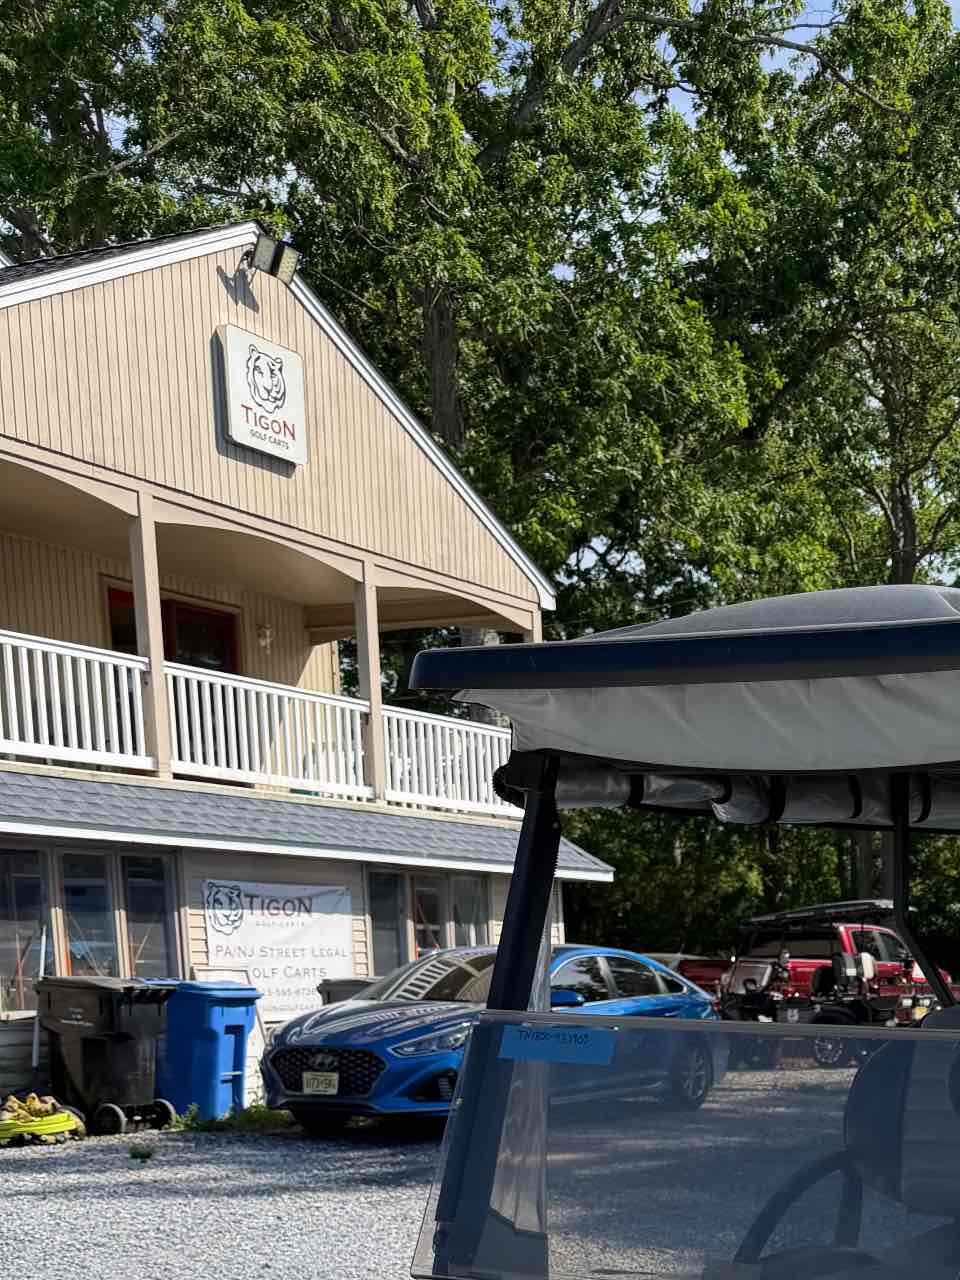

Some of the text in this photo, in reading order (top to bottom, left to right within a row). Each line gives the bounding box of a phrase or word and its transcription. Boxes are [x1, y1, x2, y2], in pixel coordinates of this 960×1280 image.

[240, 403, 296, 440] TIGON
[244, 895, 313, 917] TIGON
[252, 965, 328, 979] OLF CARTS
